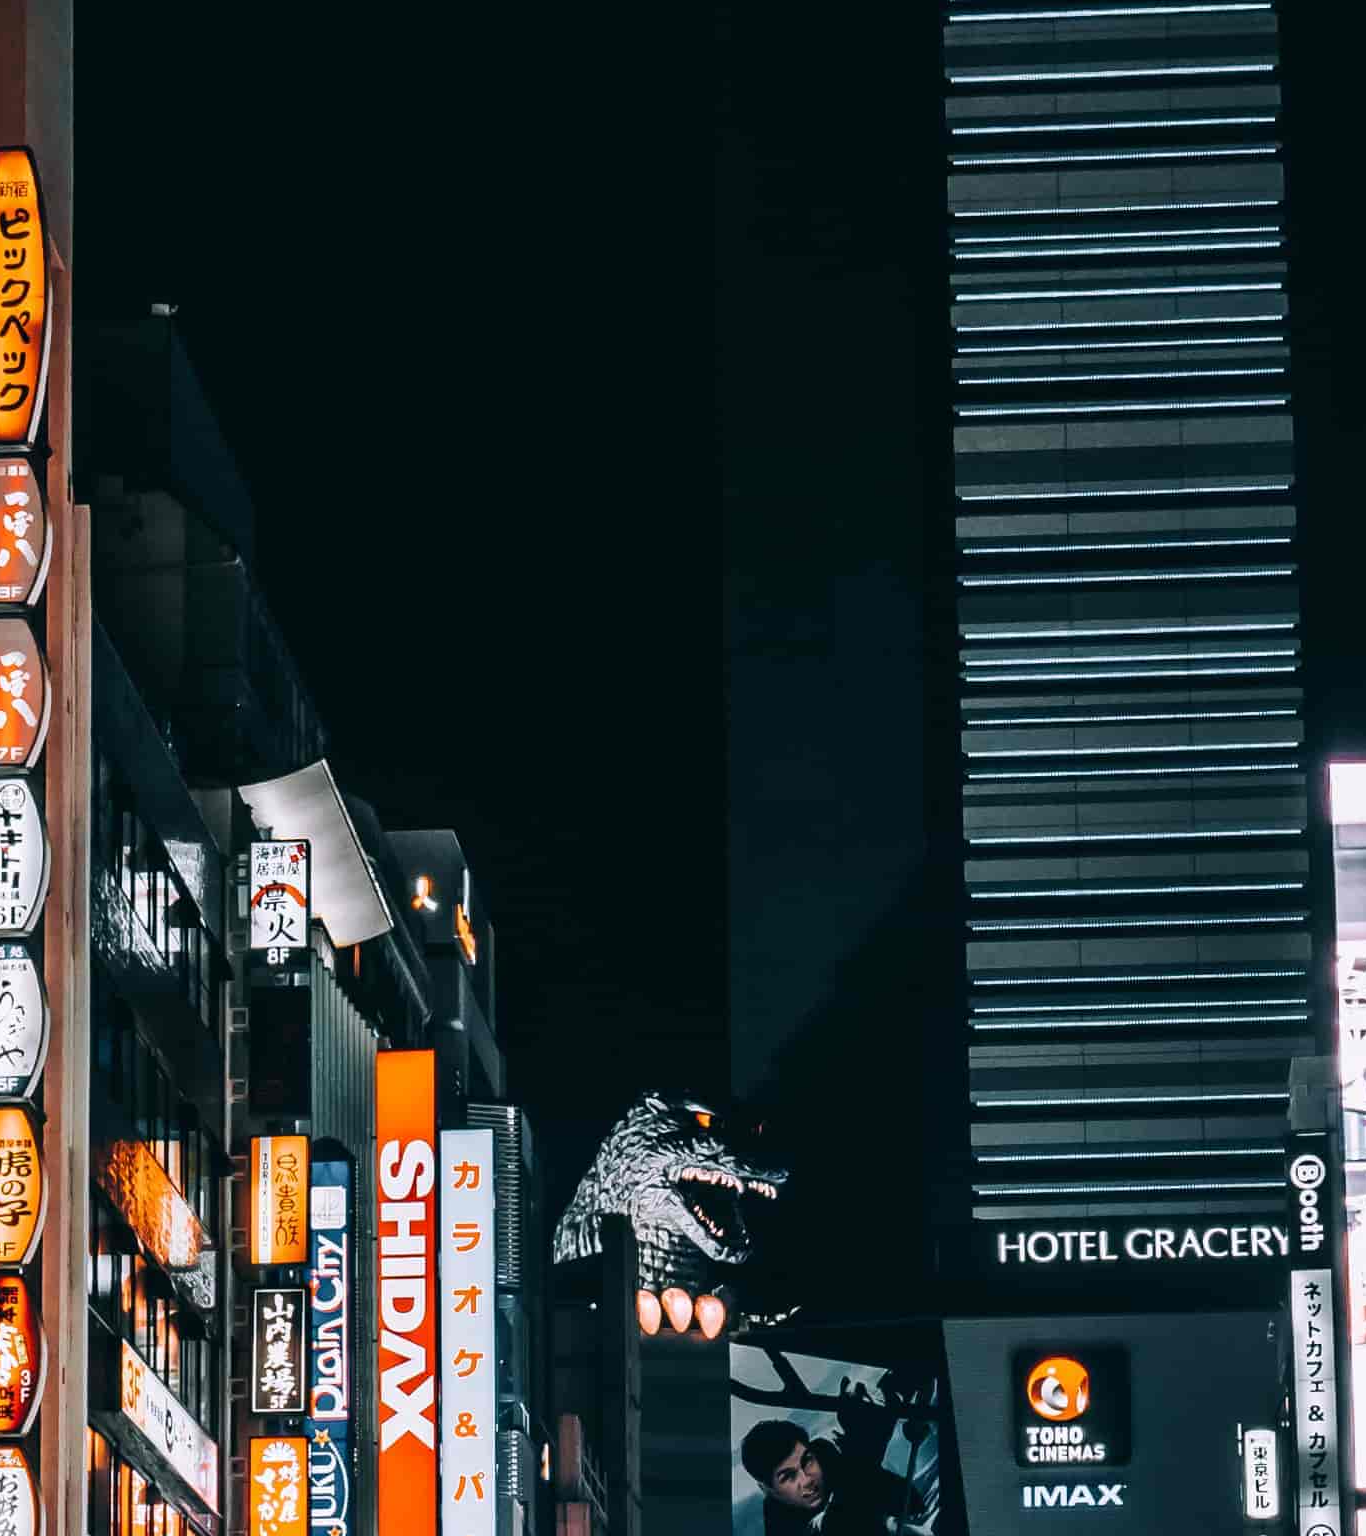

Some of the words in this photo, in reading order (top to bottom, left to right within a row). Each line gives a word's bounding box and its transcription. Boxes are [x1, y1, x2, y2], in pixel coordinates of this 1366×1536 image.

[266, 947, 290, 966] 8F
[1290, 1153, 1326, 1253] Booth
[997, 1230, 1118, 1264] HOTEL
[1124, 1226, 1290, 1261] GRACERY
[379, 1139, 435, 1451] SHIDAX
[1302, 1281, 1326, 1394] ネットカフェ
[1307, 1404, 1325, 1423] &
[1025, 1426, 1085, 1445] TOHO
[1025, 1444, 1106, 1464] CINEMAS
[1251, 1446, 1271, 1509] 東京ビル
[1307, 1432, 1329, 1509] カプセル
[1021, 1484, 1125, 1509] IMAX
